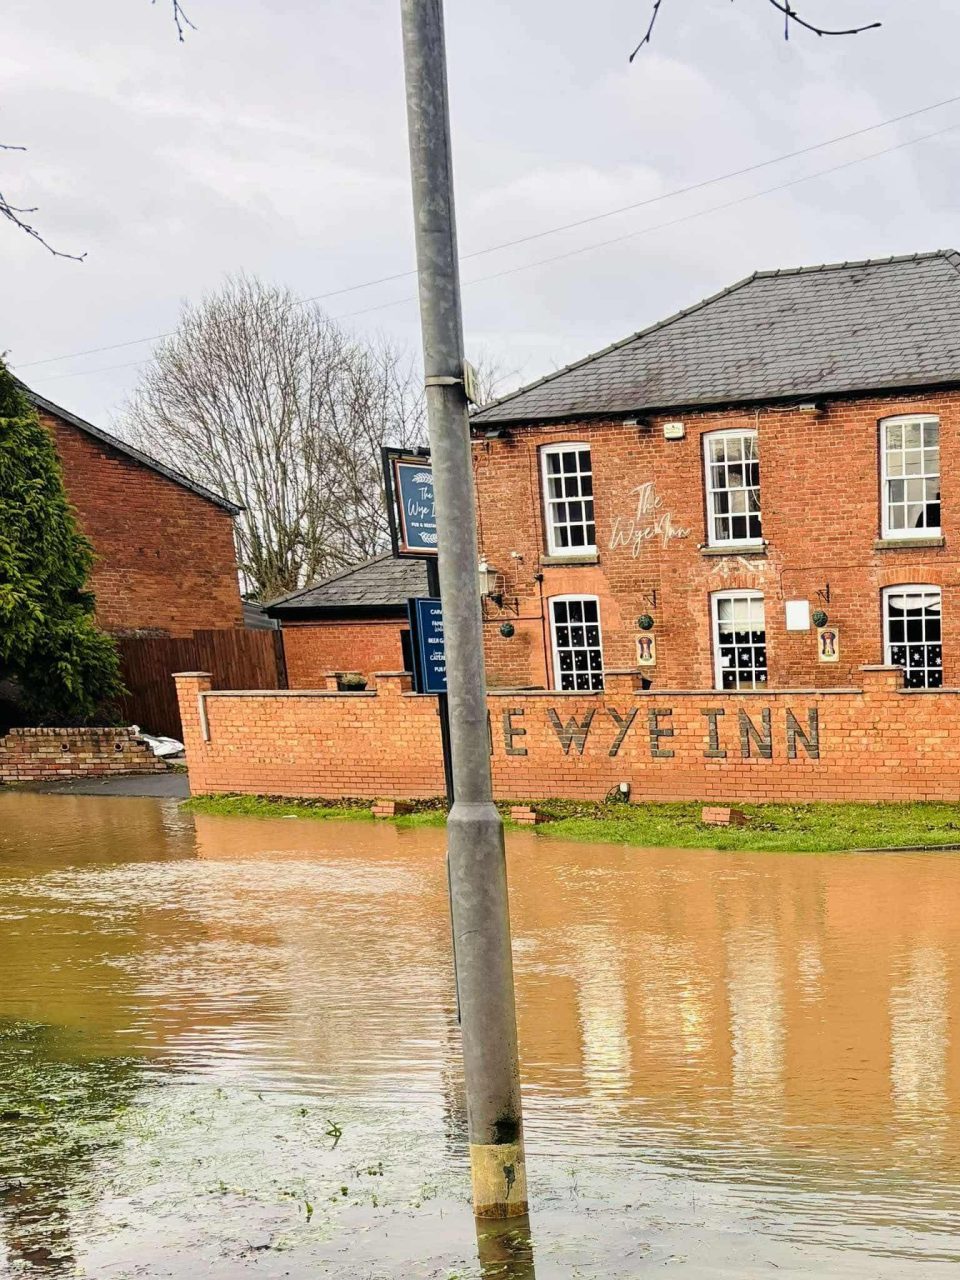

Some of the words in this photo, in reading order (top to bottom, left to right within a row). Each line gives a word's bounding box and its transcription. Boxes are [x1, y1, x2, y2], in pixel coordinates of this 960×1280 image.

[407, 498, 429, 519] Wye
[418, 486, 433, 500] The
[628, 481, 663, 522] The
[608, 516, 656, 560] Wye
[658, 512, 693, 550] Inn
[546, 707, 675, 757] WYE
[700, 708, 820, 759] INN
